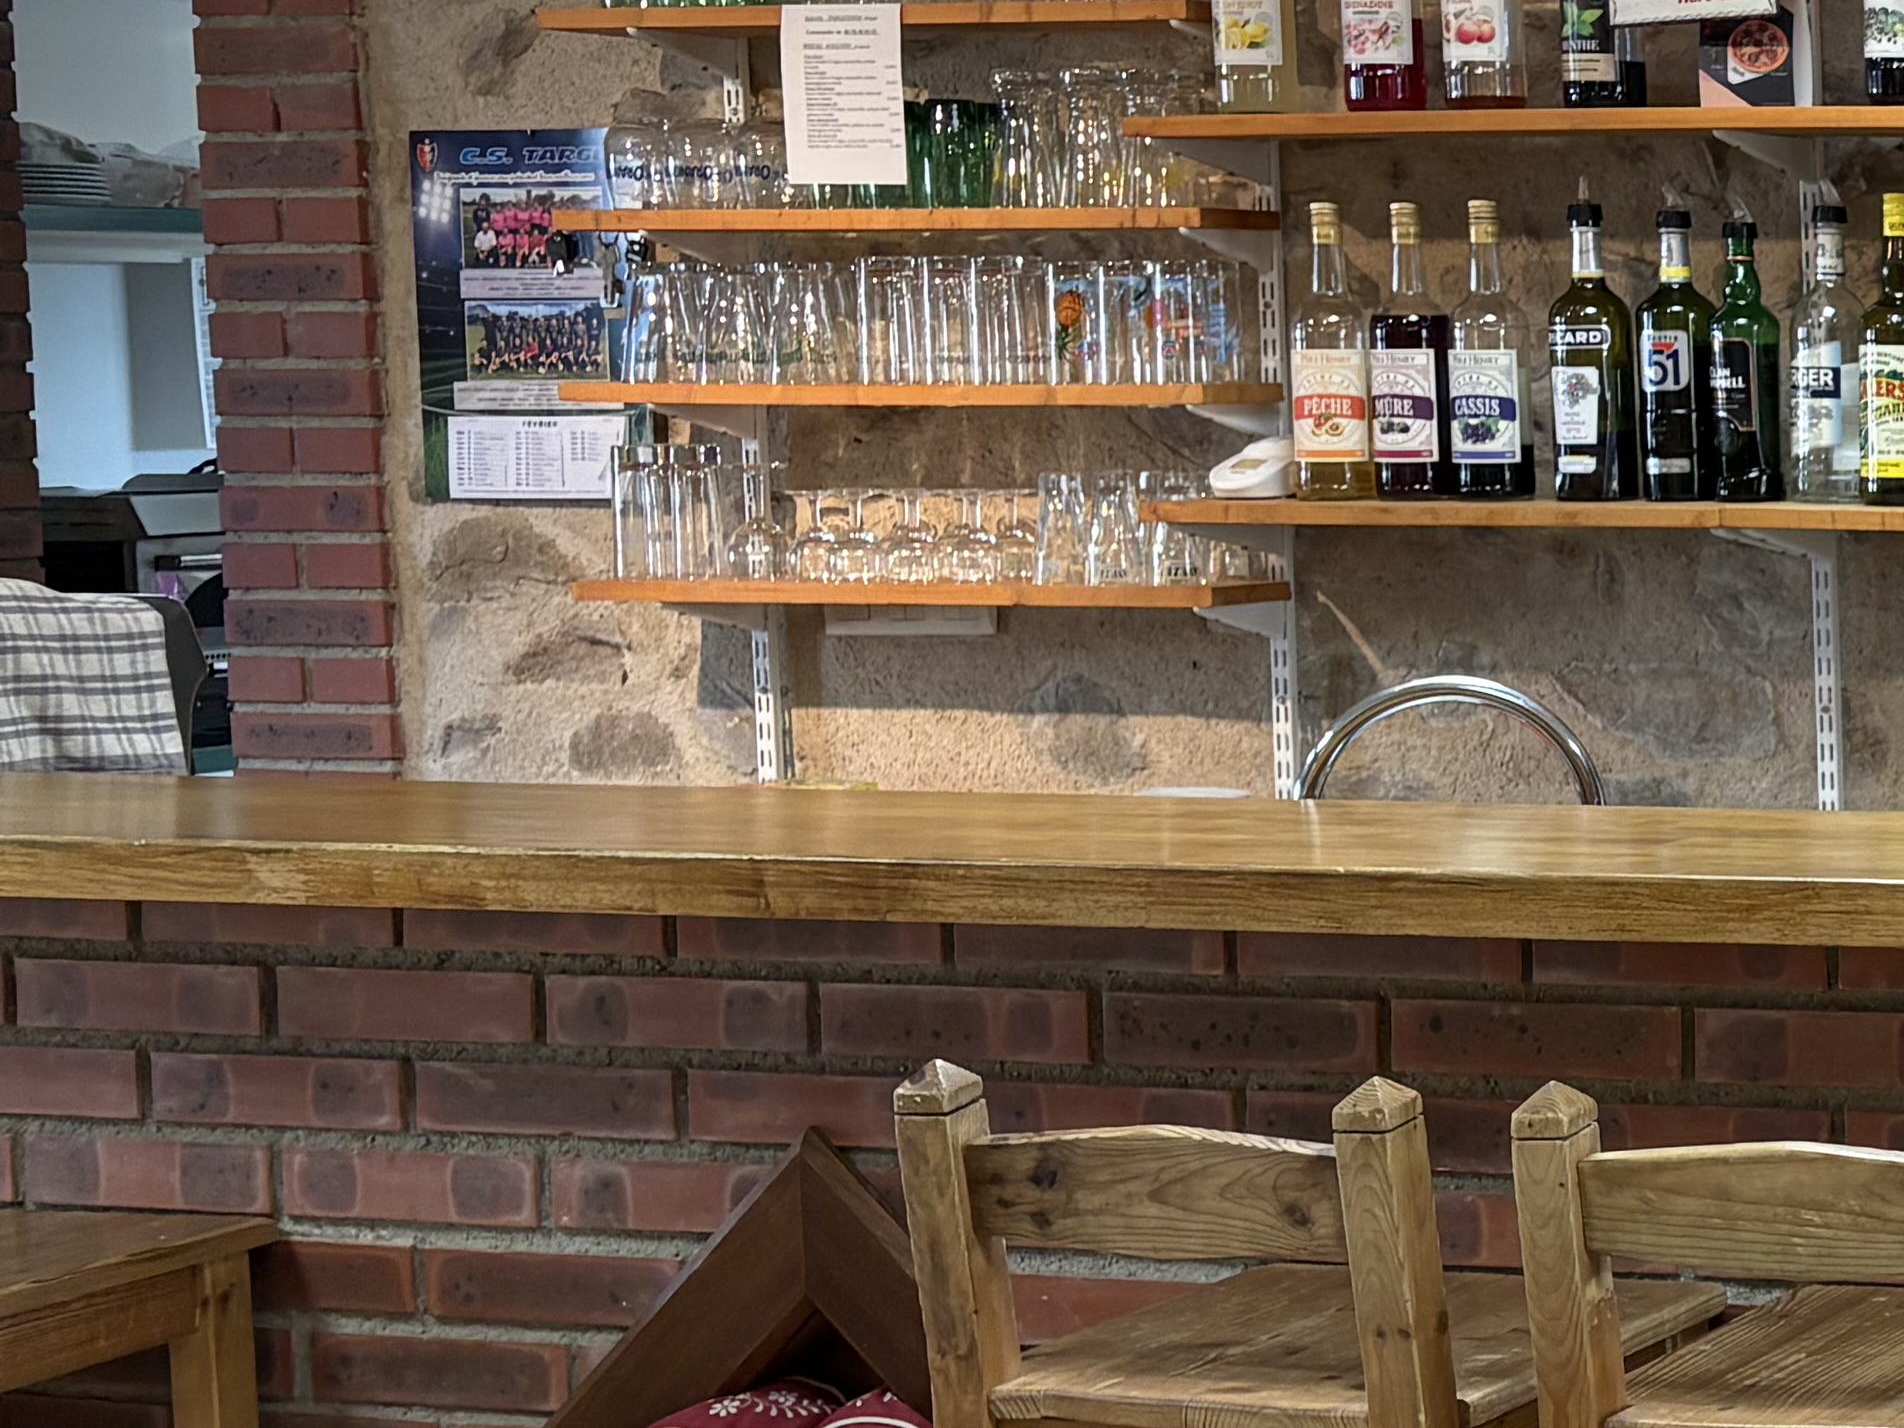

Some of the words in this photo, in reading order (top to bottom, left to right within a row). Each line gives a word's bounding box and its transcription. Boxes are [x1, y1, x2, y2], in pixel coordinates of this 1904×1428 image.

[460, 147, 513, 164] C.S.
[1649, 349, 1681, 386] 51
[1792, 369, 1835, 388] RGER
[1303, 396, 1352, 415] PÊCHE
[1375, 395, 1414, 416] MÛRE
[1454, 398, 1501, 415] CASSIS
